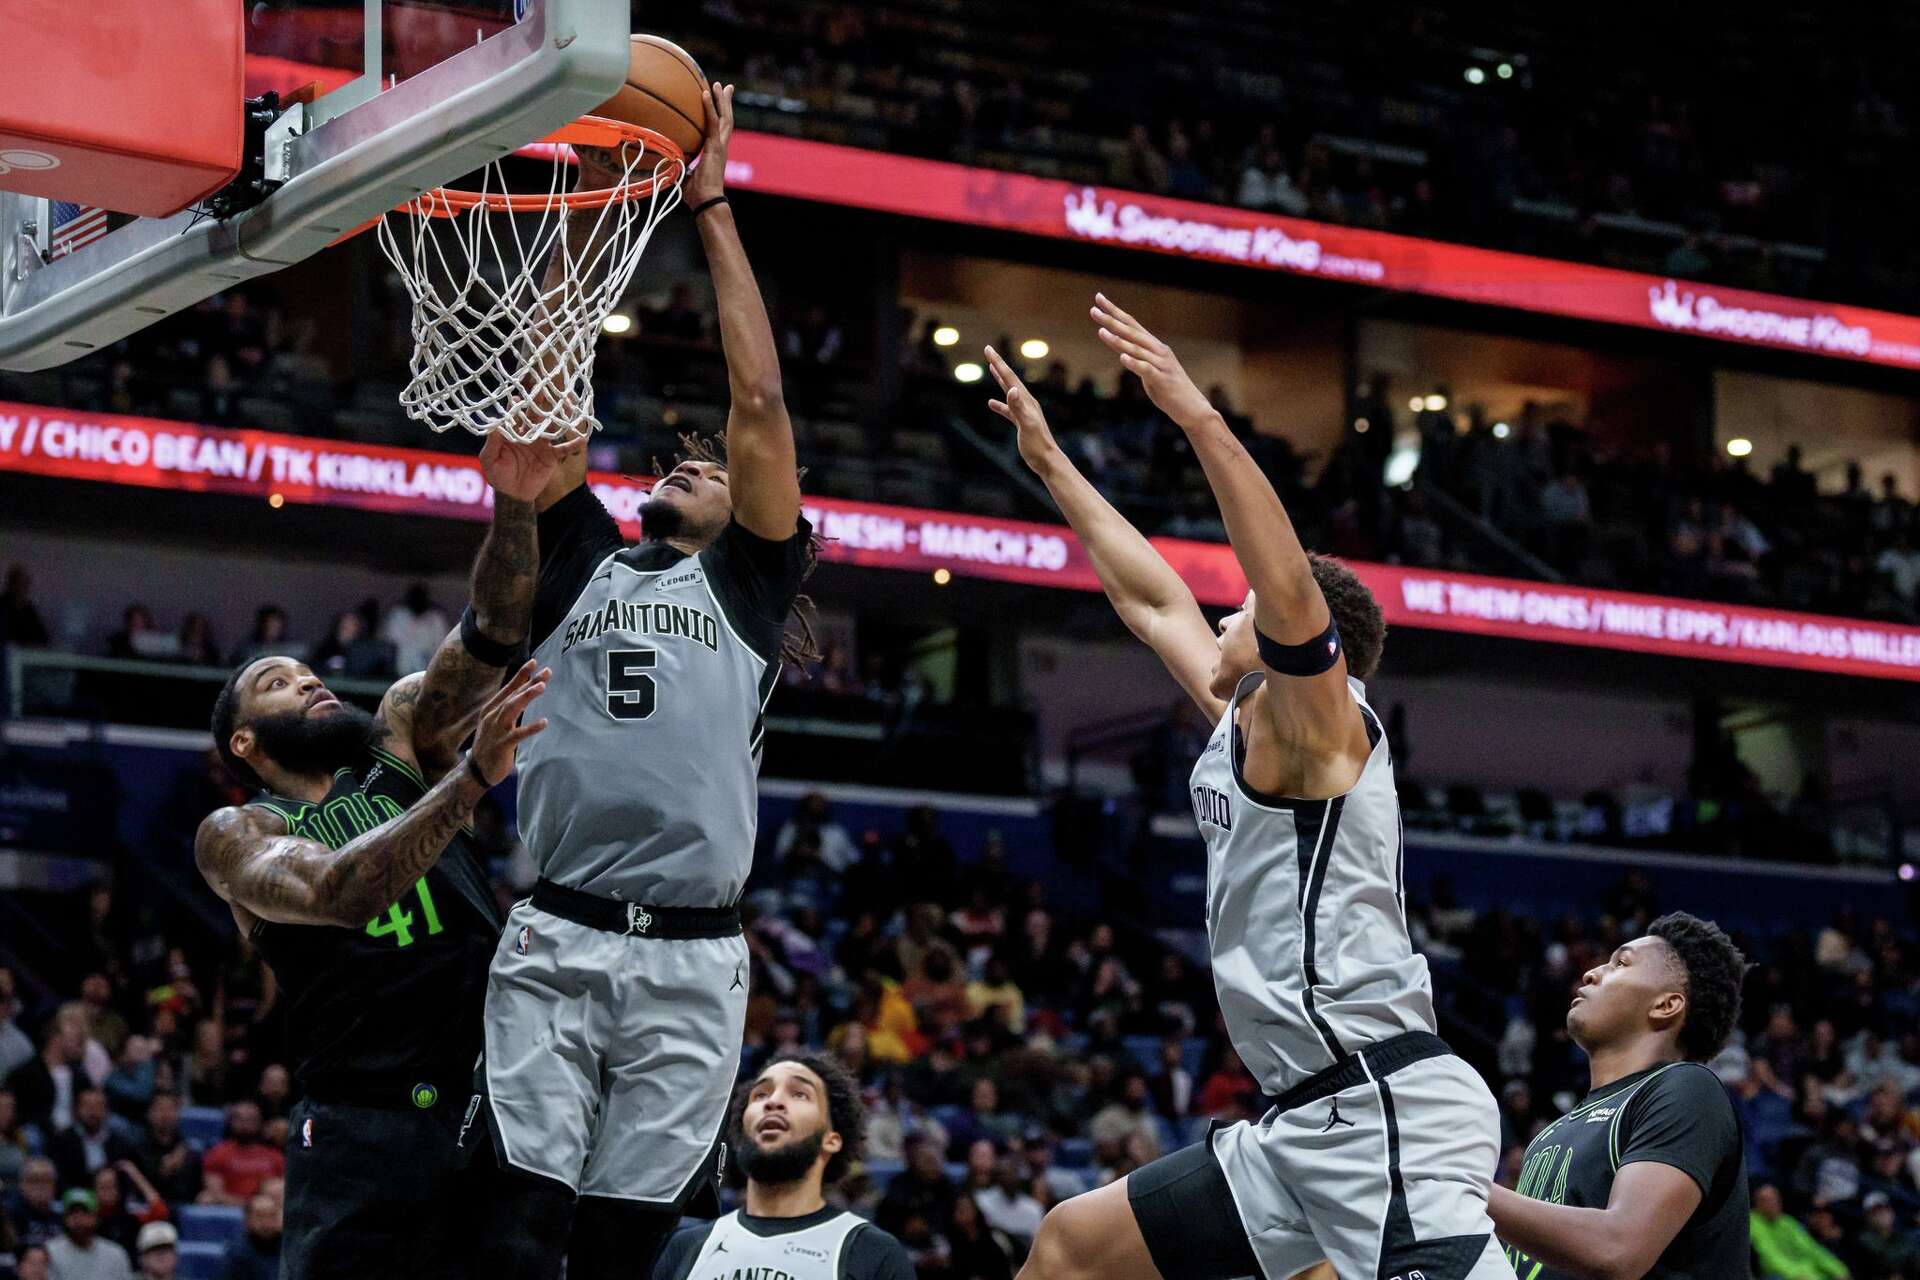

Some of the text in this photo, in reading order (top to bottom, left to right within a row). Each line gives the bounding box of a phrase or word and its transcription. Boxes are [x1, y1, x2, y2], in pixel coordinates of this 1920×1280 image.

[41, 420, 150, 467] CHICO
[152, 432, 247, 478] BEAN
[267, 445, 315, 486] TK
[316, 452, 485, 504] KIRKLAND
[824, 511, 905, 551] NESH
[920, 521, 1026, 566] MARCH
[1026, 533, 1068, 571] 20
[660, 573, 696, 587] LEDGER
[601, 598, 719, 655] ANTONIO
[1402, 577, 1446, 614] WE
[1448, 581, 1521, 622] THEM
[1522, 590, 1589, 631] ONES
[1602, 601, 1665, 639] MIKE
[1665, 607, 1727, 646] EPPS
[1741, 618, 1849, 659] KARLOUS
[606, 648, 657, 721] 5
[365, 875, 445, 947] 41
